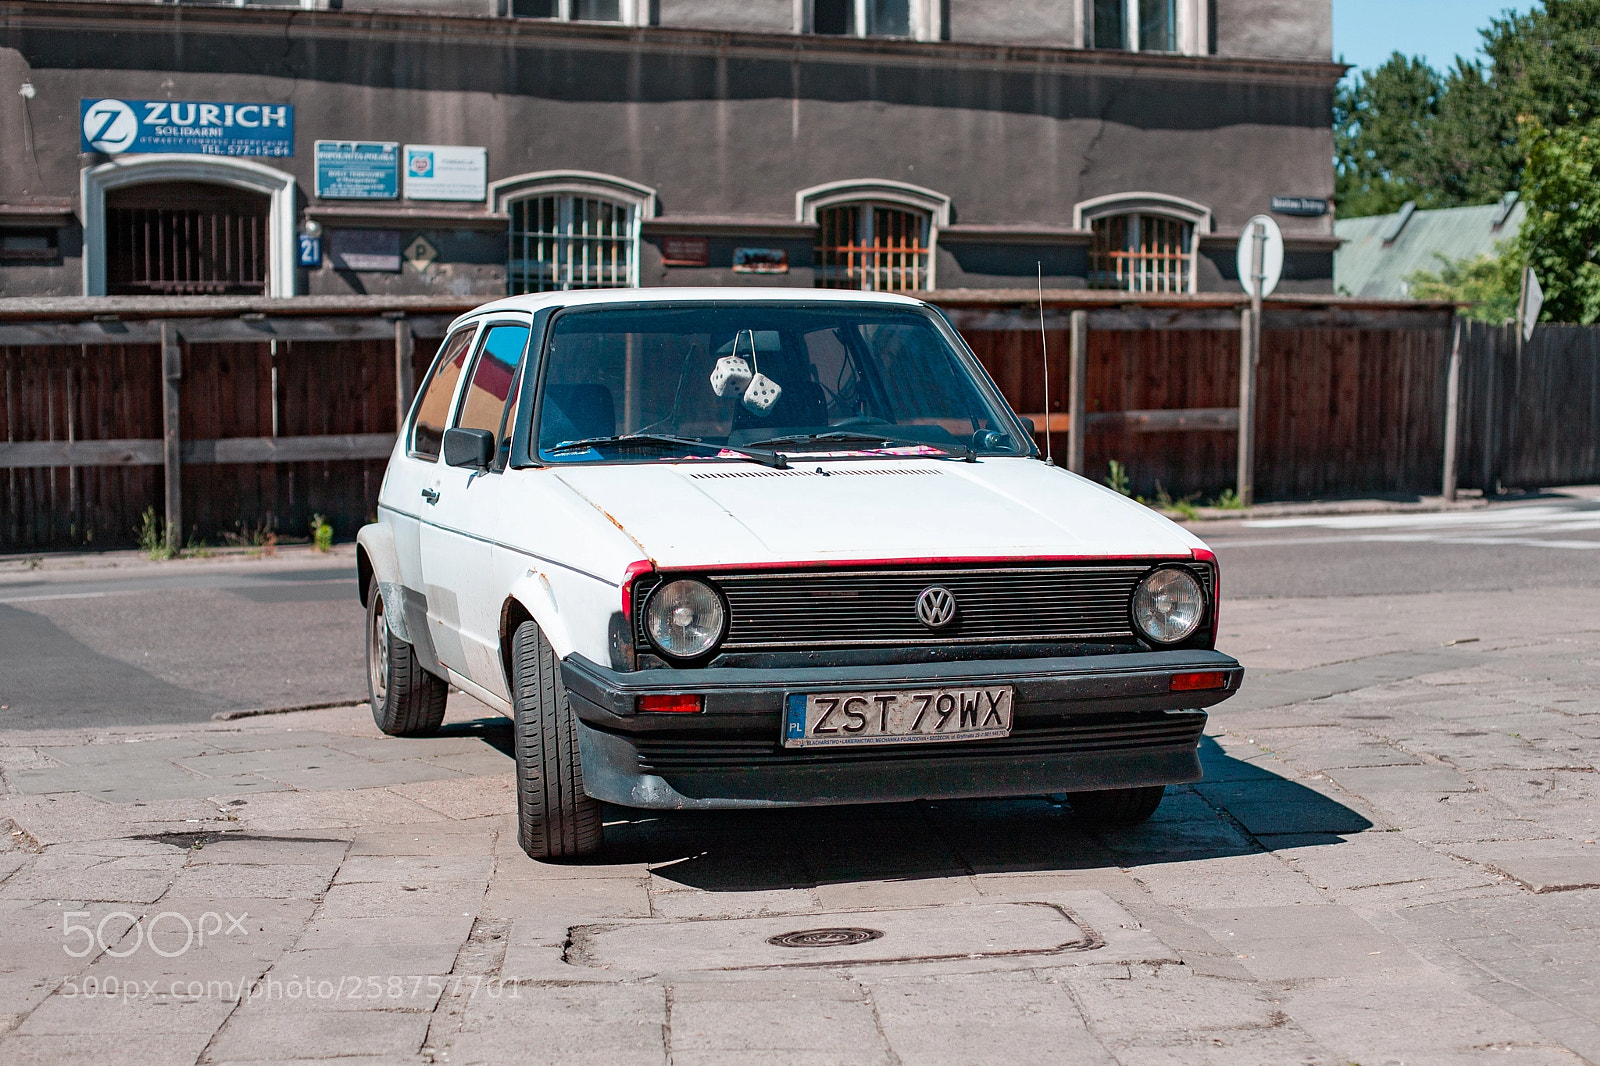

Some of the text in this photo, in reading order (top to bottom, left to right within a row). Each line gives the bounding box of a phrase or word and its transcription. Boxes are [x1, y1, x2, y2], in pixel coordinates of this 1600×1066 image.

[143, 102, 287, 128] ZURICH
[154, 125, 224, 138] SOLIDARNI
[202, 144, 225, 155] TEL.
[300, 239, 320, 262] 21
[415, 244, 426, 260] P
[918, 588, 955, 627] VW
[812, 689, 1007, 734] ZST 79WX
[789, 722, 803, 733] PL
